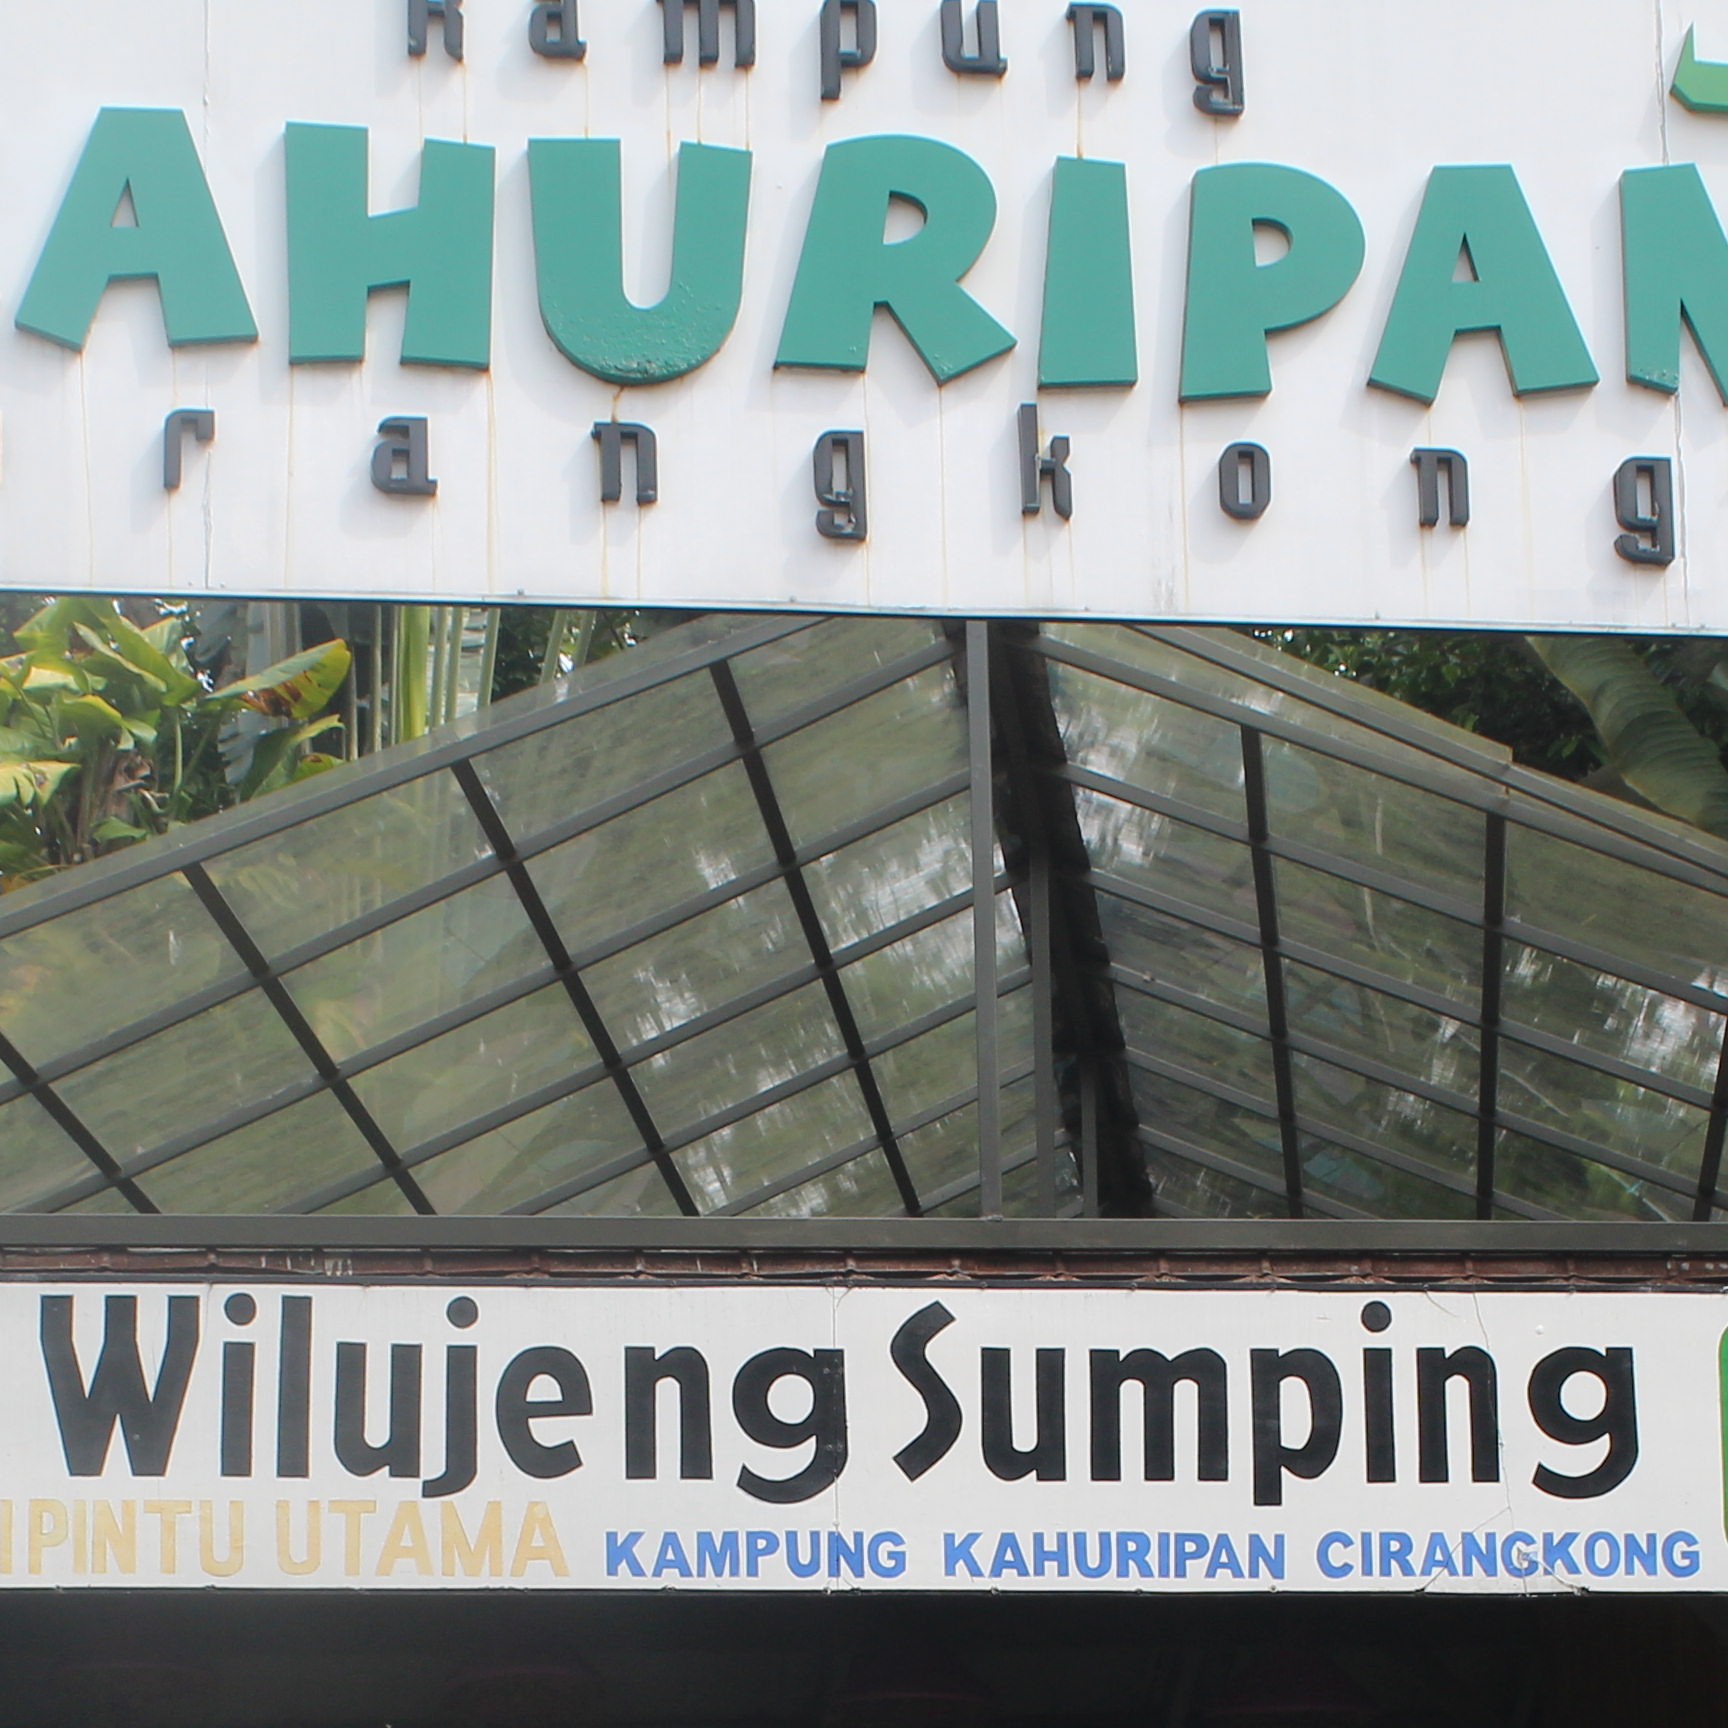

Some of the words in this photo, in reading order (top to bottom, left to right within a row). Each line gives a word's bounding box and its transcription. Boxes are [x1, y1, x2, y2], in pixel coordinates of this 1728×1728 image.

[40, 1295, 849, 1504] Wilujeng
[890, 1300, 1639, 1507] Sumping
[28, 1498, 244, 1577] PINTU
[277, 1500, 569, 1577] UTAMA
[606, 1530, 906, 1578] KAMPUNG
[944, 1531, 1285, 1579] KAHURIPAN
[1317, 1531, 1700, 1578] CIRANGKONG
